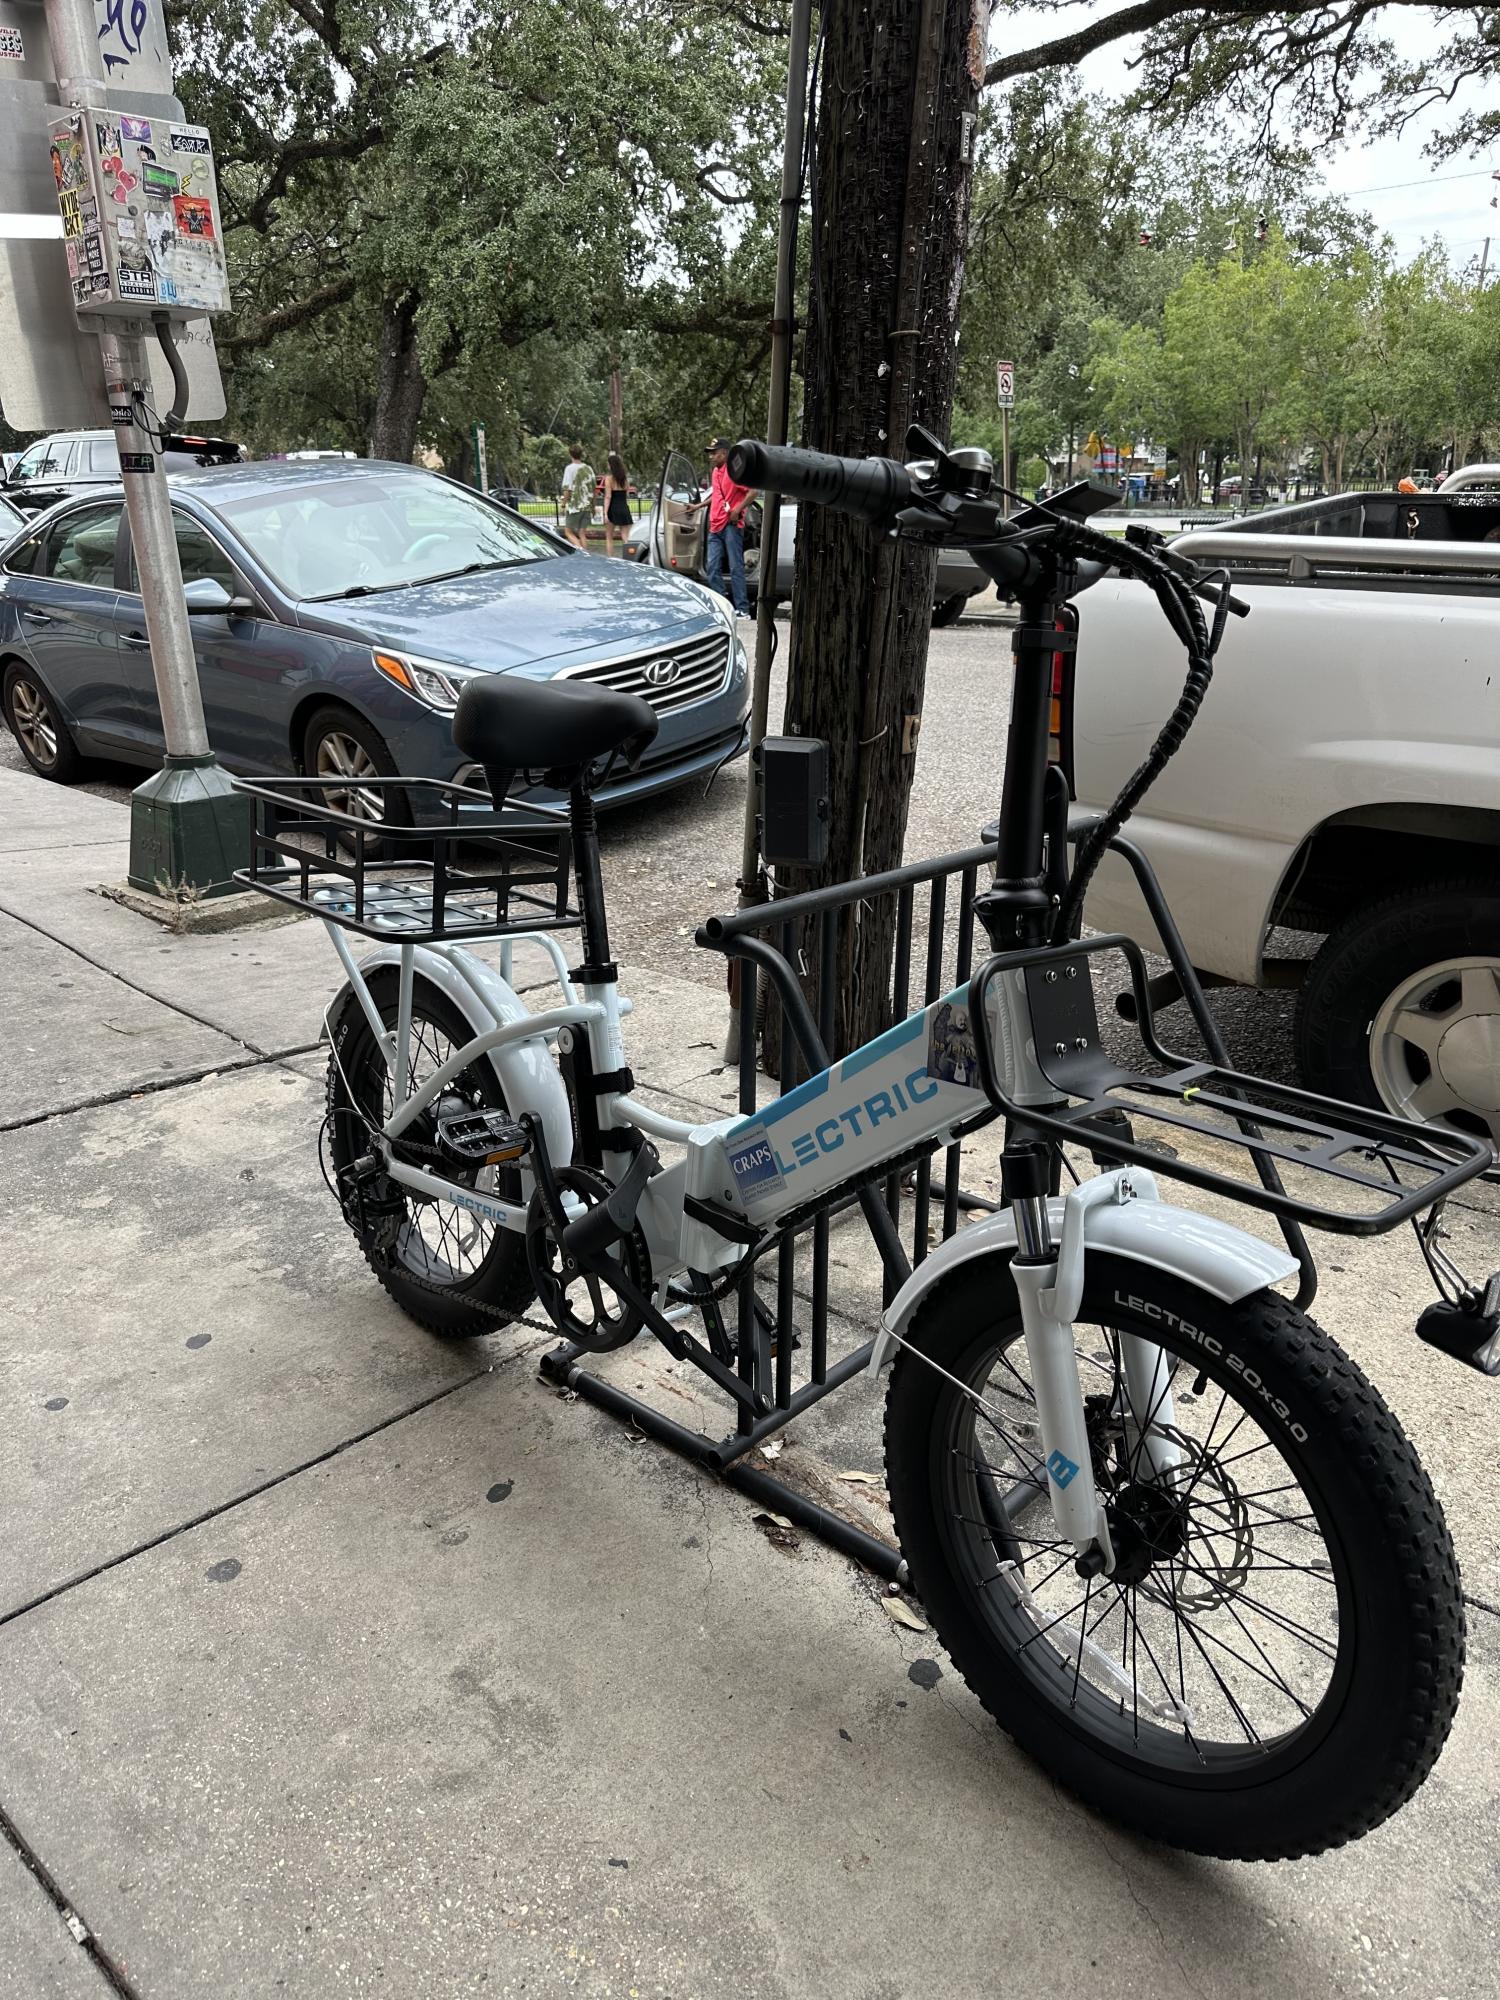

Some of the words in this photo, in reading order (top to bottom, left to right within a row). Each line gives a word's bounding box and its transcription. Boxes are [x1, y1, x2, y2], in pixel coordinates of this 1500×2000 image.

[88, 249, 100, 260] MORE
[89, 259, 102, 270] TREES
[775, 1066, 939, 1175] LECTRIC
[733, 1145, 772, 1174] CRAPS
[449, 1191, 507, 1222] LECTRIC
[1114, 1290, 1222, 1356] LECTRIC
[1225, 1353, 1309, 1444] 20x3.0
